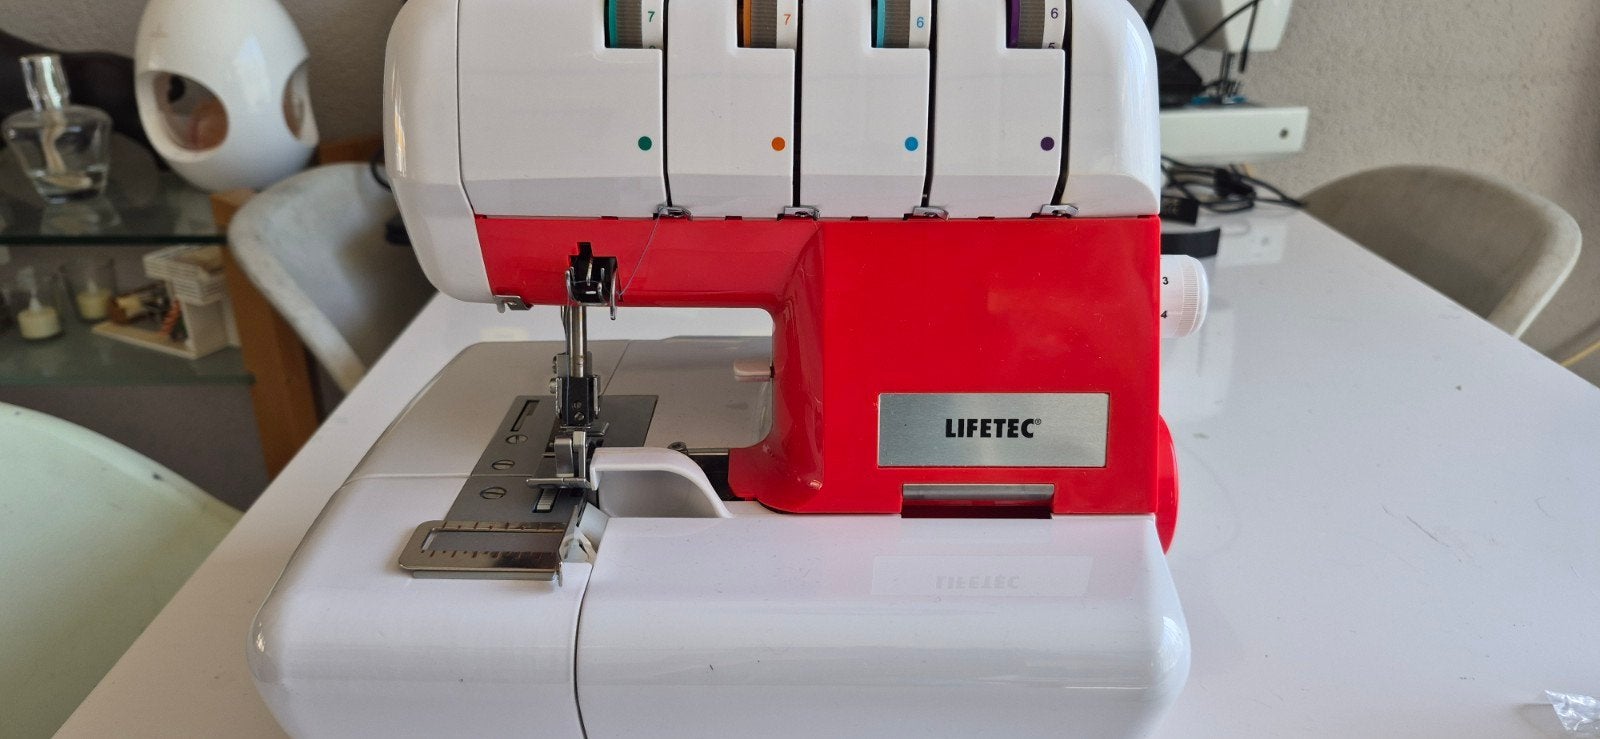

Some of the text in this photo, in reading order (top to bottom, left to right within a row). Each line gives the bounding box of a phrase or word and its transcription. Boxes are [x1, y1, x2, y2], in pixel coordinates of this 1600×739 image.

[647, 11, 656, 22] 7
[1050, 8, 1059, 19] 6
[783, 14, 792, 25] 7
[916, 16, 925, 28] 6
[1162, 276, 1169, 285] 3
[1160, 310, 1168, 319] 4
